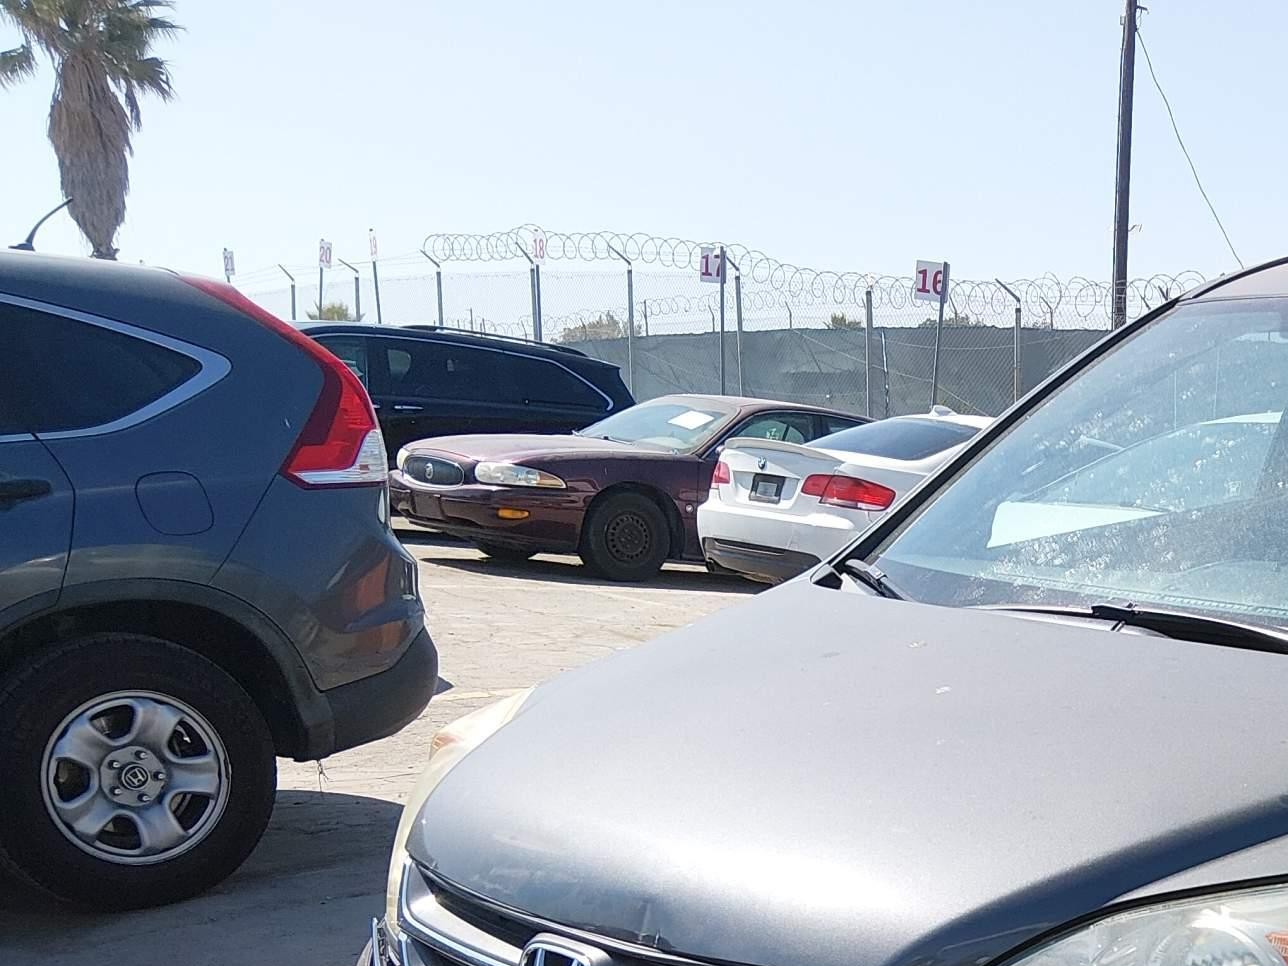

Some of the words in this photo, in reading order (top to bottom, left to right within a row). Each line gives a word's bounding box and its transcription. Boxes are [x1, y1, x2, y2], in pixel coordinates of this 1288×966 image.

[320, 246, 331, 264] 20
[533, 238, 544, 259] 18
[701, 254, 720, 277] 17
[917, 269, 942, 296] 16
